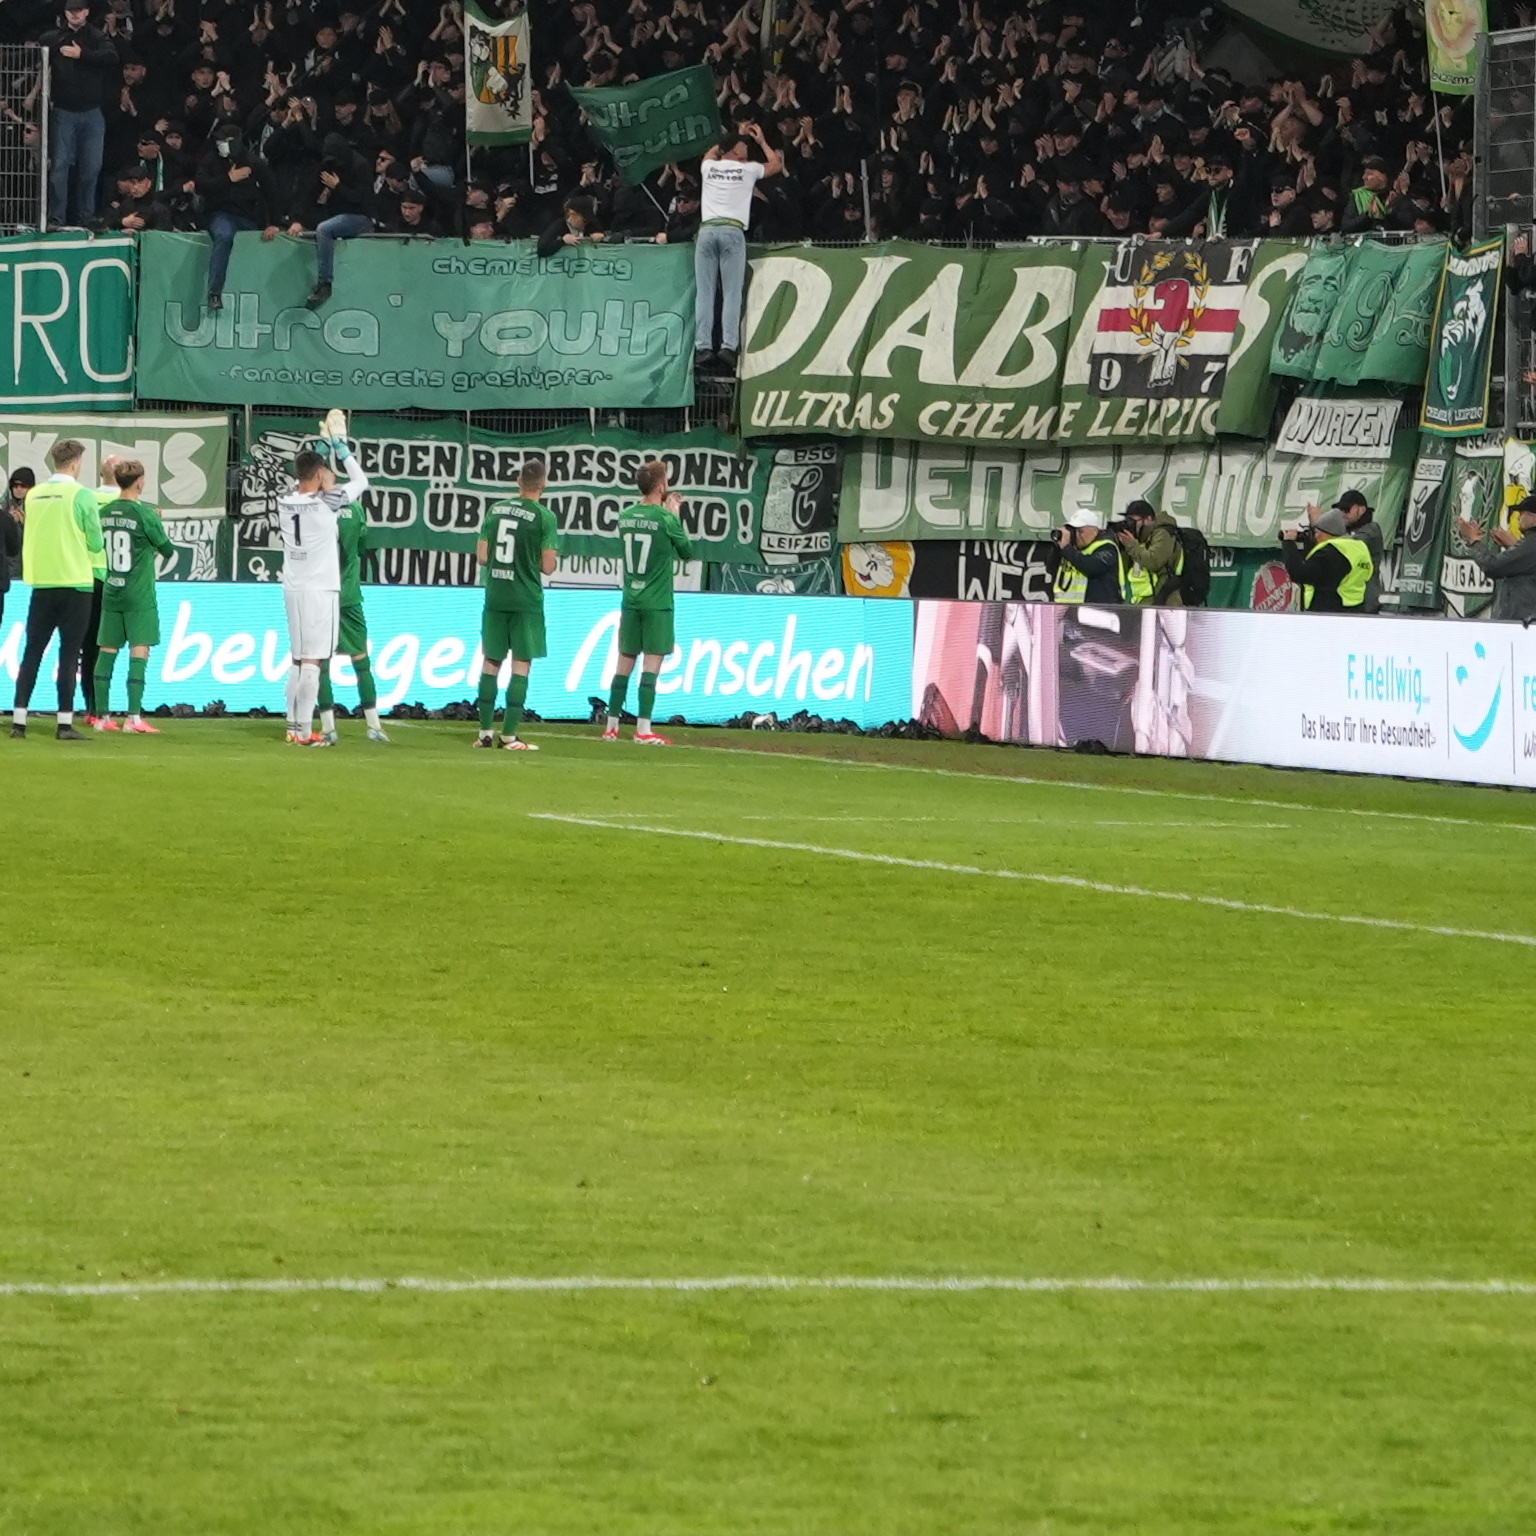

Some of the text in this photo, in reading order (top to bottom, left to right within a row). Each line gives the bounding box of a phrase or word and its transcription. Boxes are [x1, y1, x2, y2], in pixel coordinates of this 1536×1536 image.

[1098, 358, 1226, 394] 9 7
[750, 390, 900, 431] ULTRAS
[794, 446, 837, 462] BSG
[290, 514, 302, 546] 1
[496, 518, 519, 564] 5
[767, 534, 832, 550] LEIPZIG
[103, 529, 132, 573] 18
[623, 532, 652, 575] 17
[1347, 654, 1423, 715] F. Hellwig
[1301, 713, 1432, 749] Das Haus für Ihre Gesundheit
